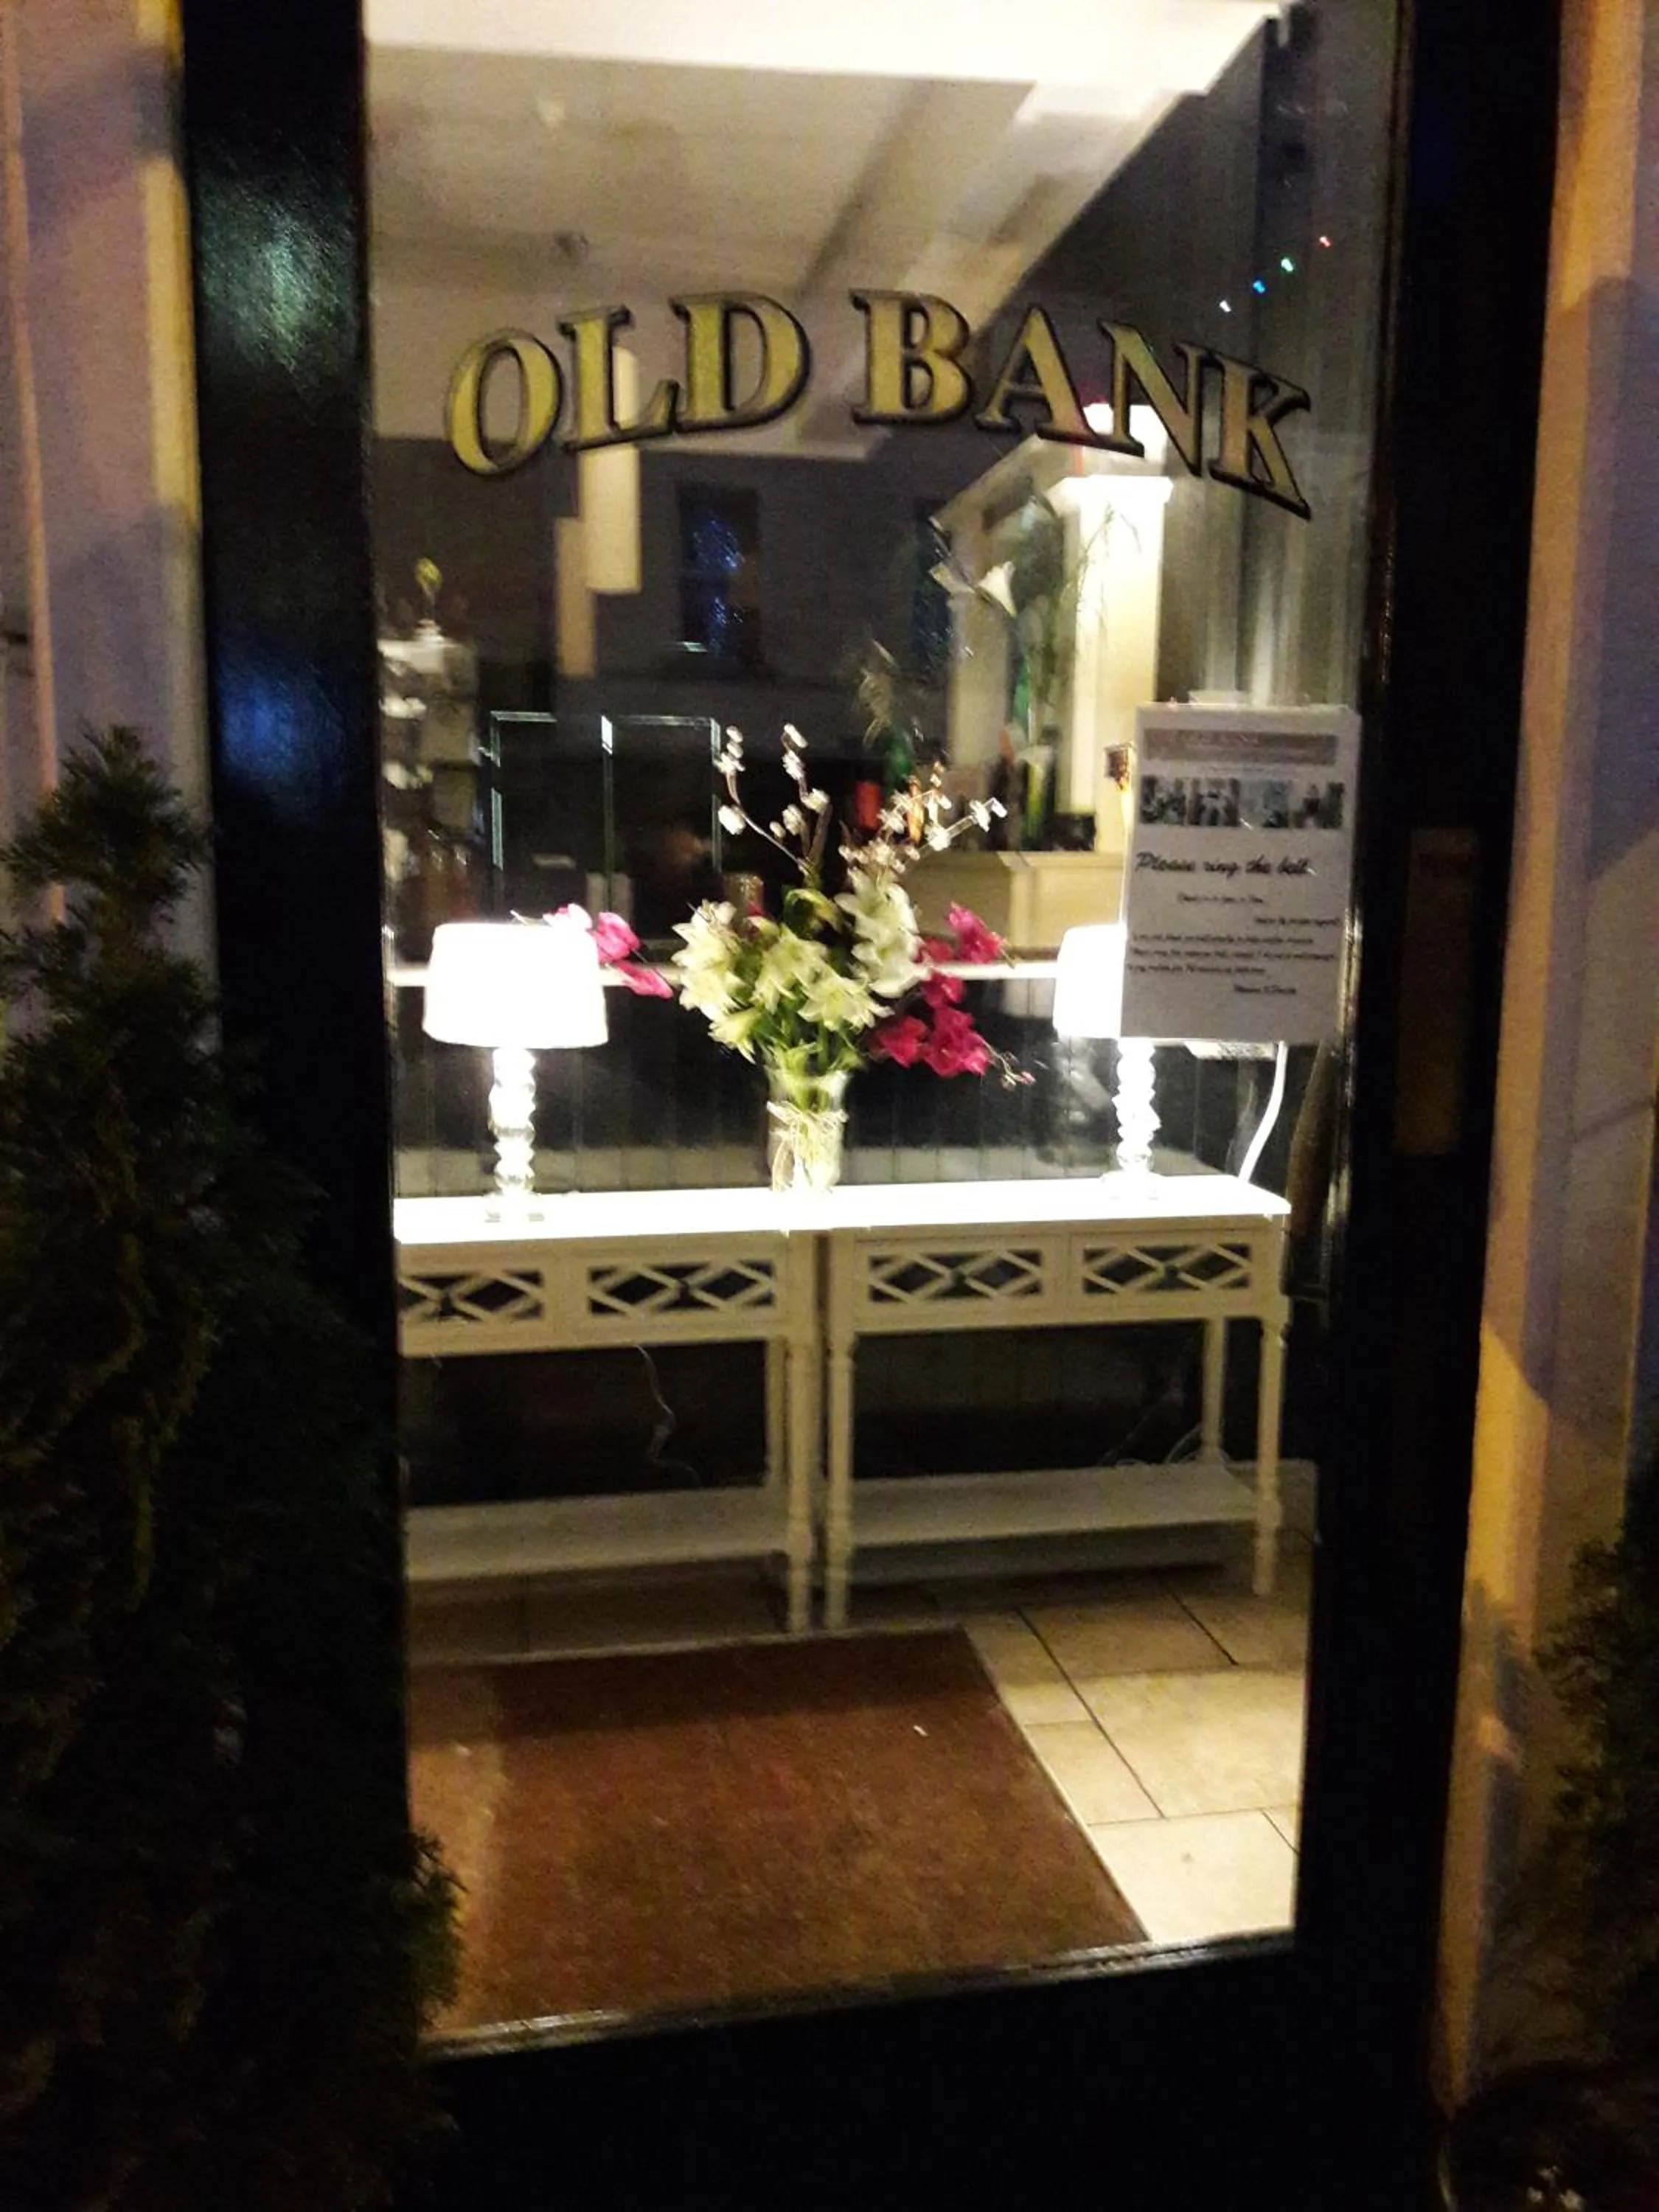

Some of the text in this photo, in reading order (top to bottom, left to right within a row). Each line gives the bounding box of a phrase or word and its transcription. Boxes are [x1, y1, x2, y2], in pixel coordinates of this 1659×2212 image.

[446, 288, 1312, 521] OLD BANK
[1135, 851, 1196, 872] Please
[1246, 853, 1271, 874] the
